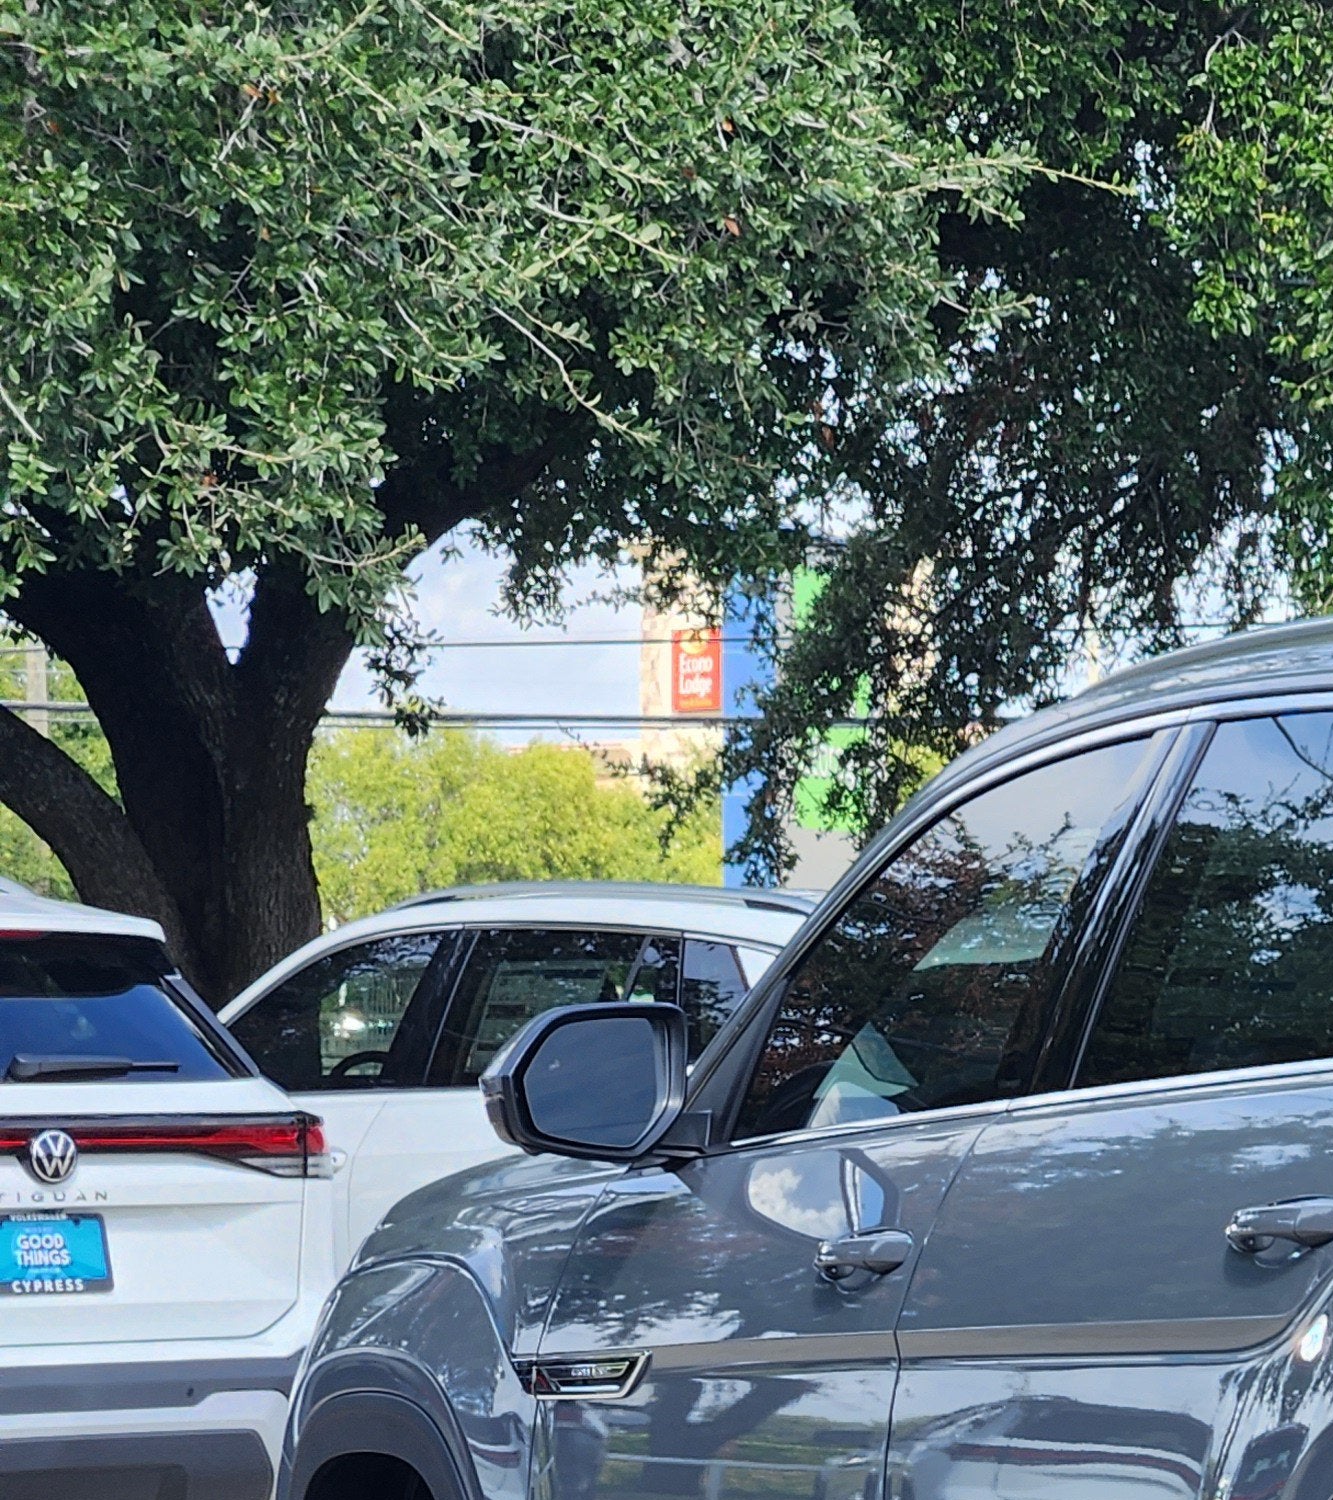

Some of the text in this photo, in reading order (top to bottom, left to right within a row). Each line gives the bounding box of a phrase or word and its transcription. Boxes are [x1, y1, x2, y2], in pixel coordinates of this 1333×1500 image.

[17, 1233, 64, 1250] GOOD
[15, 1249, 71, 1266] THINGS
[12, 1279, 84, 1293] CYPRESS
